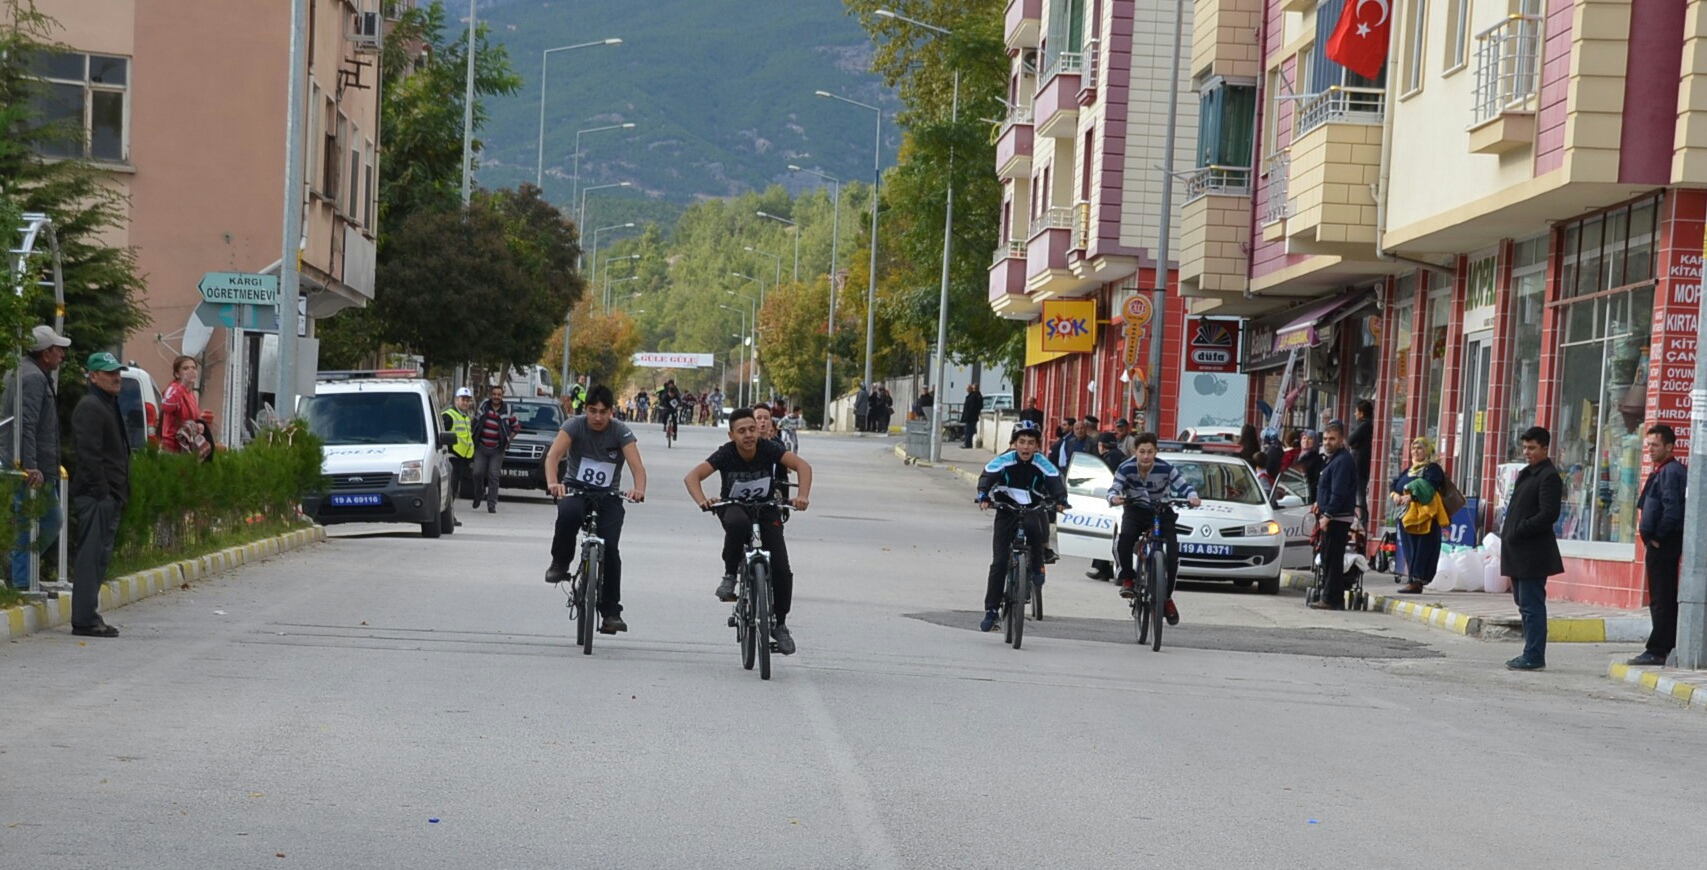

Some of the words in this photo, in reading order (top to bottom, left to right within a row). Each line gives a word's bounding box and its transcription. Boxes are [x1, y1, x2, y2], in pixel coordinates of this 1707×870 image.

[229, 277, 262, 286] KARGI
[1046, 318, 1089, 340] ŞOK
[1198, 352, 1224, 361] düfa
[1667, 368, 1694, 379] OYUN
[583, 468, 606, 486] 89
[739, 487, 764, 502] 32
[1062, 514, 1112, 529] POLİS
[1183, 544, 1194, 553] 19
[1196, 545, 1205, 554] A
[1206, 545, 1229, 555] 8371
